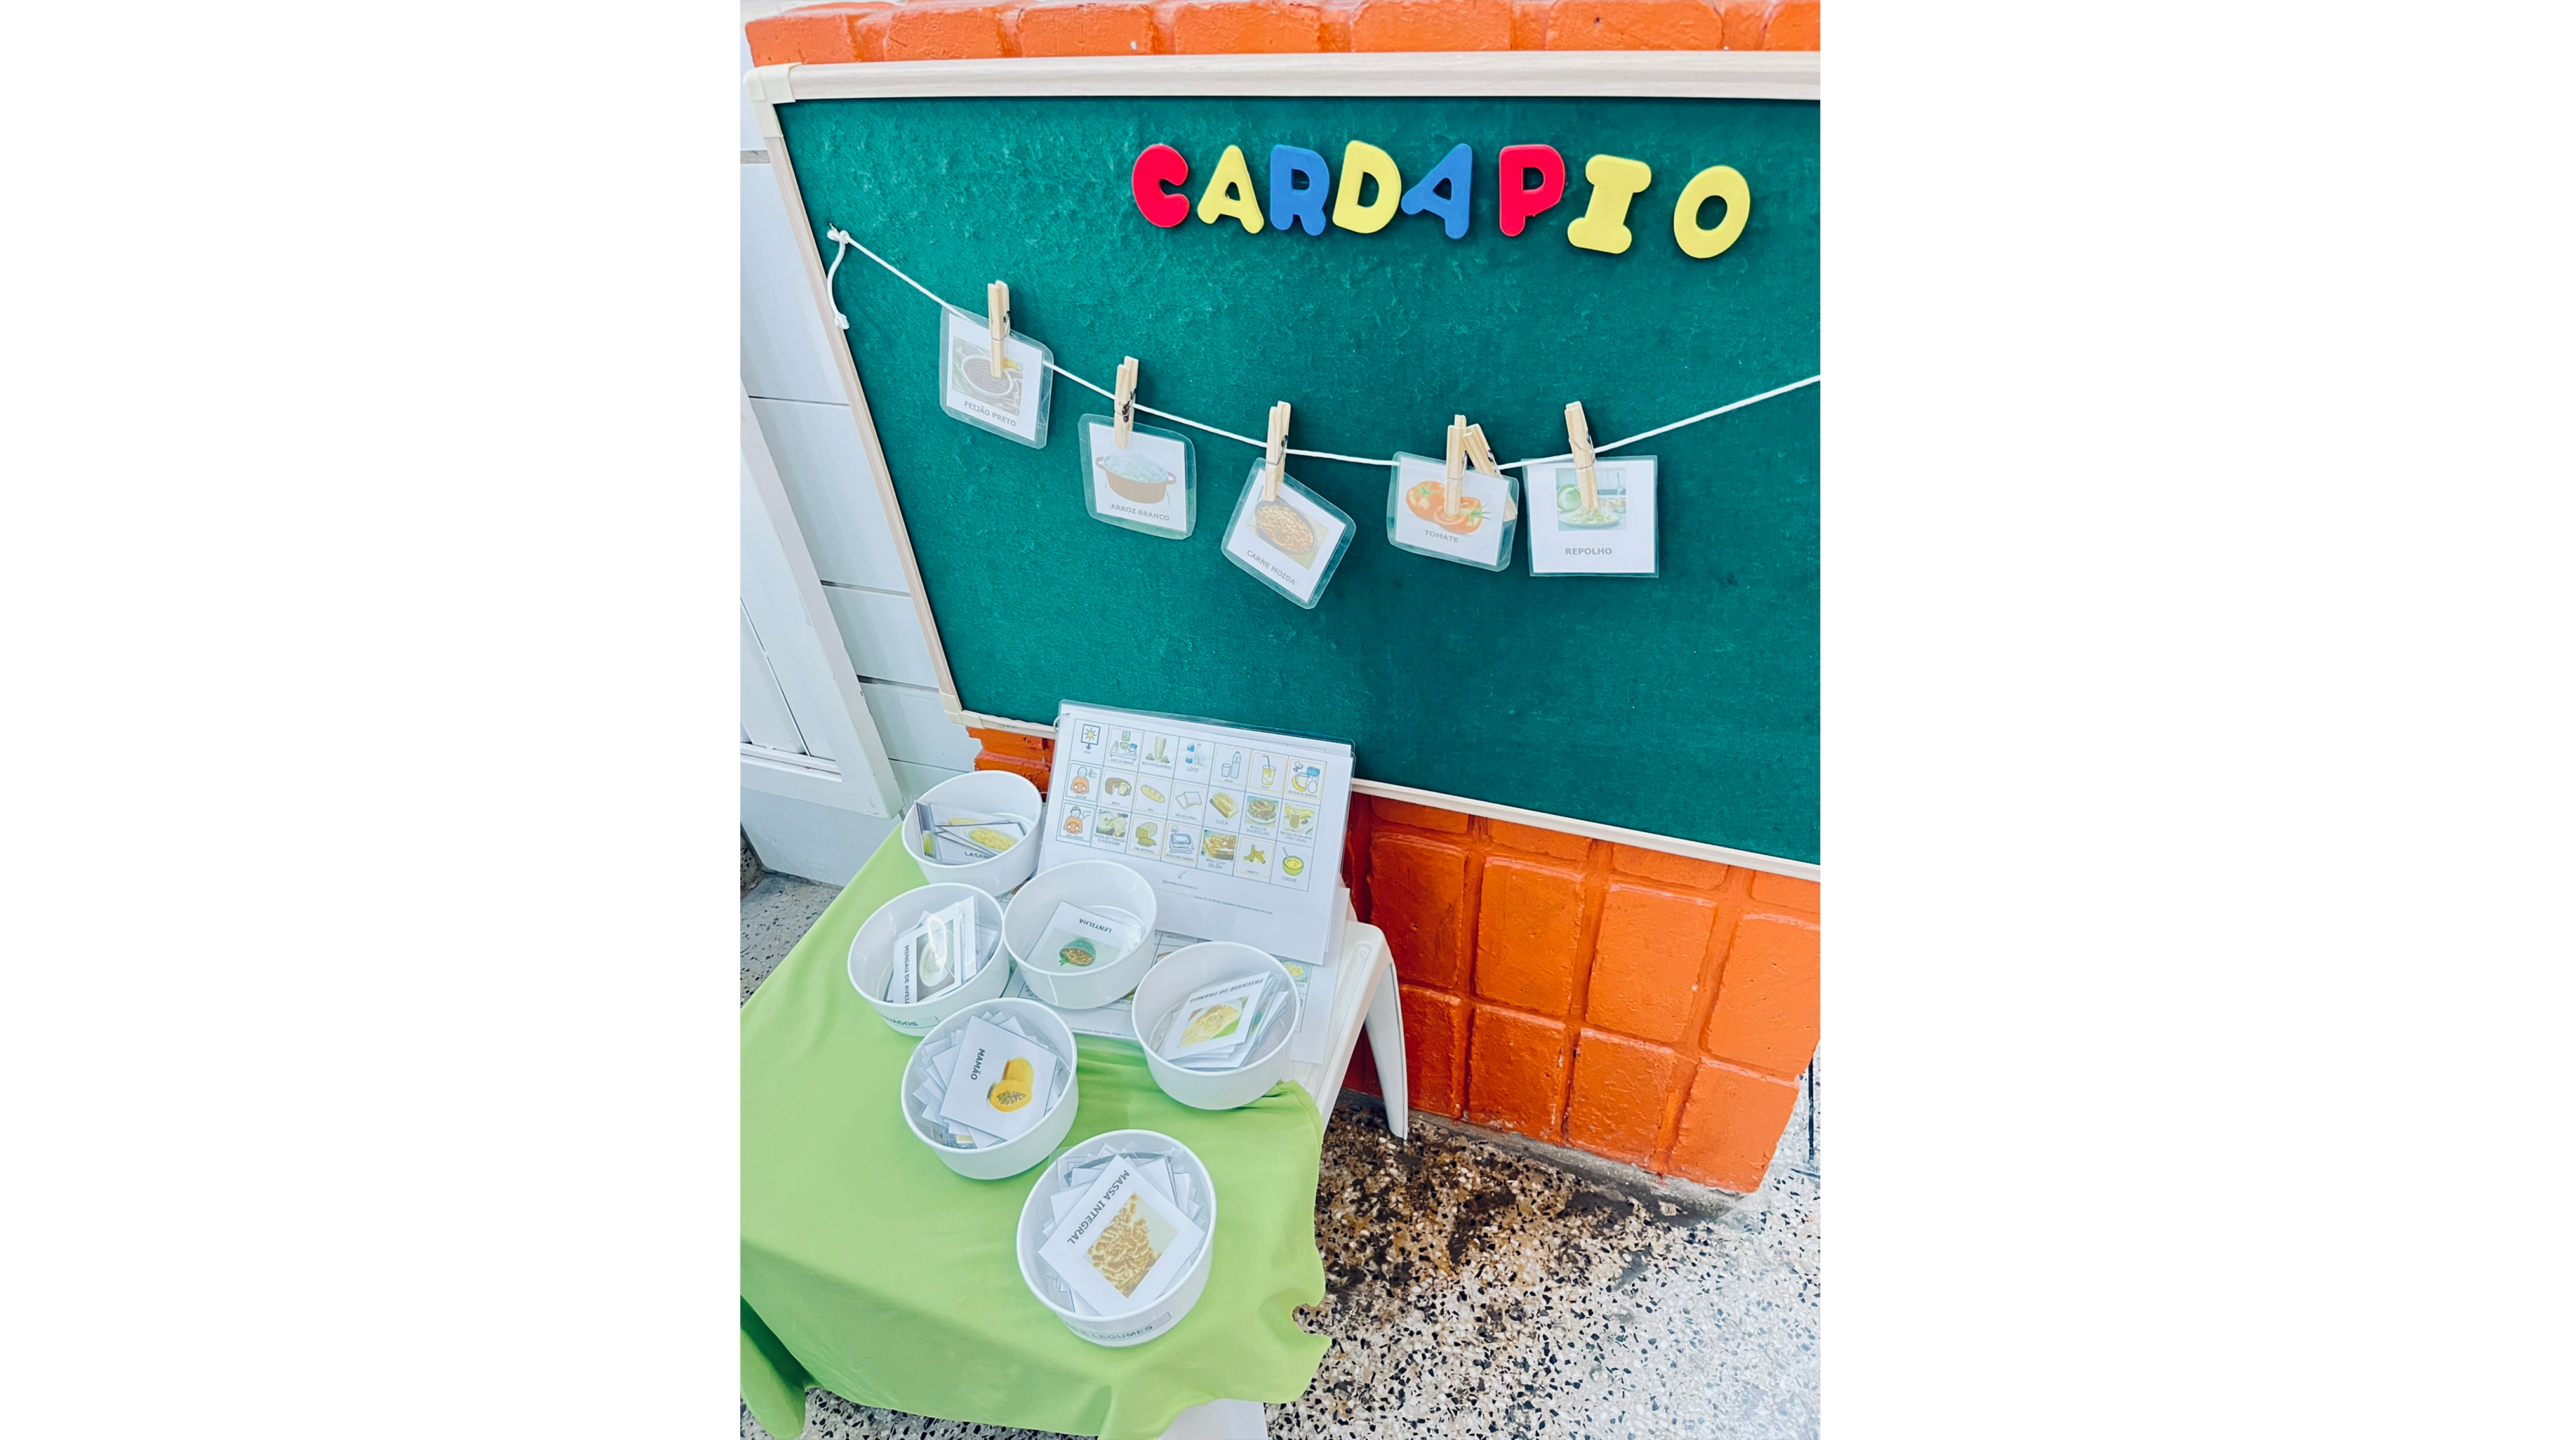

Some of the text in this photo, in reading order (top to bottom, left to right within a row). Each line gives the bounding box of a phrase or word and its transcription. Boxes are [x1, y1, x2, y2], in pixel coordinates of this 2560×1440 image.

[1131, 139, 1751, 259] CARDAPIO
[964, 401, 1017, 427] FEIJÃO PRETO
[1111, 503, 1170, 521] ARROZ BRANCO
[1424, 529, 1459, 543] TOMATE
[1246, 550, 1271, 569] CARNE
[1565, 547, 1613, 556] REPOLHO
[1079, 918, 1112, 933] LENTILHA
[904, 974, 910, 984] DE
[1190, 991, 1218, 1003] FRANGO
[970, 1048, 986, 1081] MAMÃO
[1066, 1169, 1131, 1245] MASSA INTEGRAL
[1091, 1325, 1153, 1340] LEGUMES
